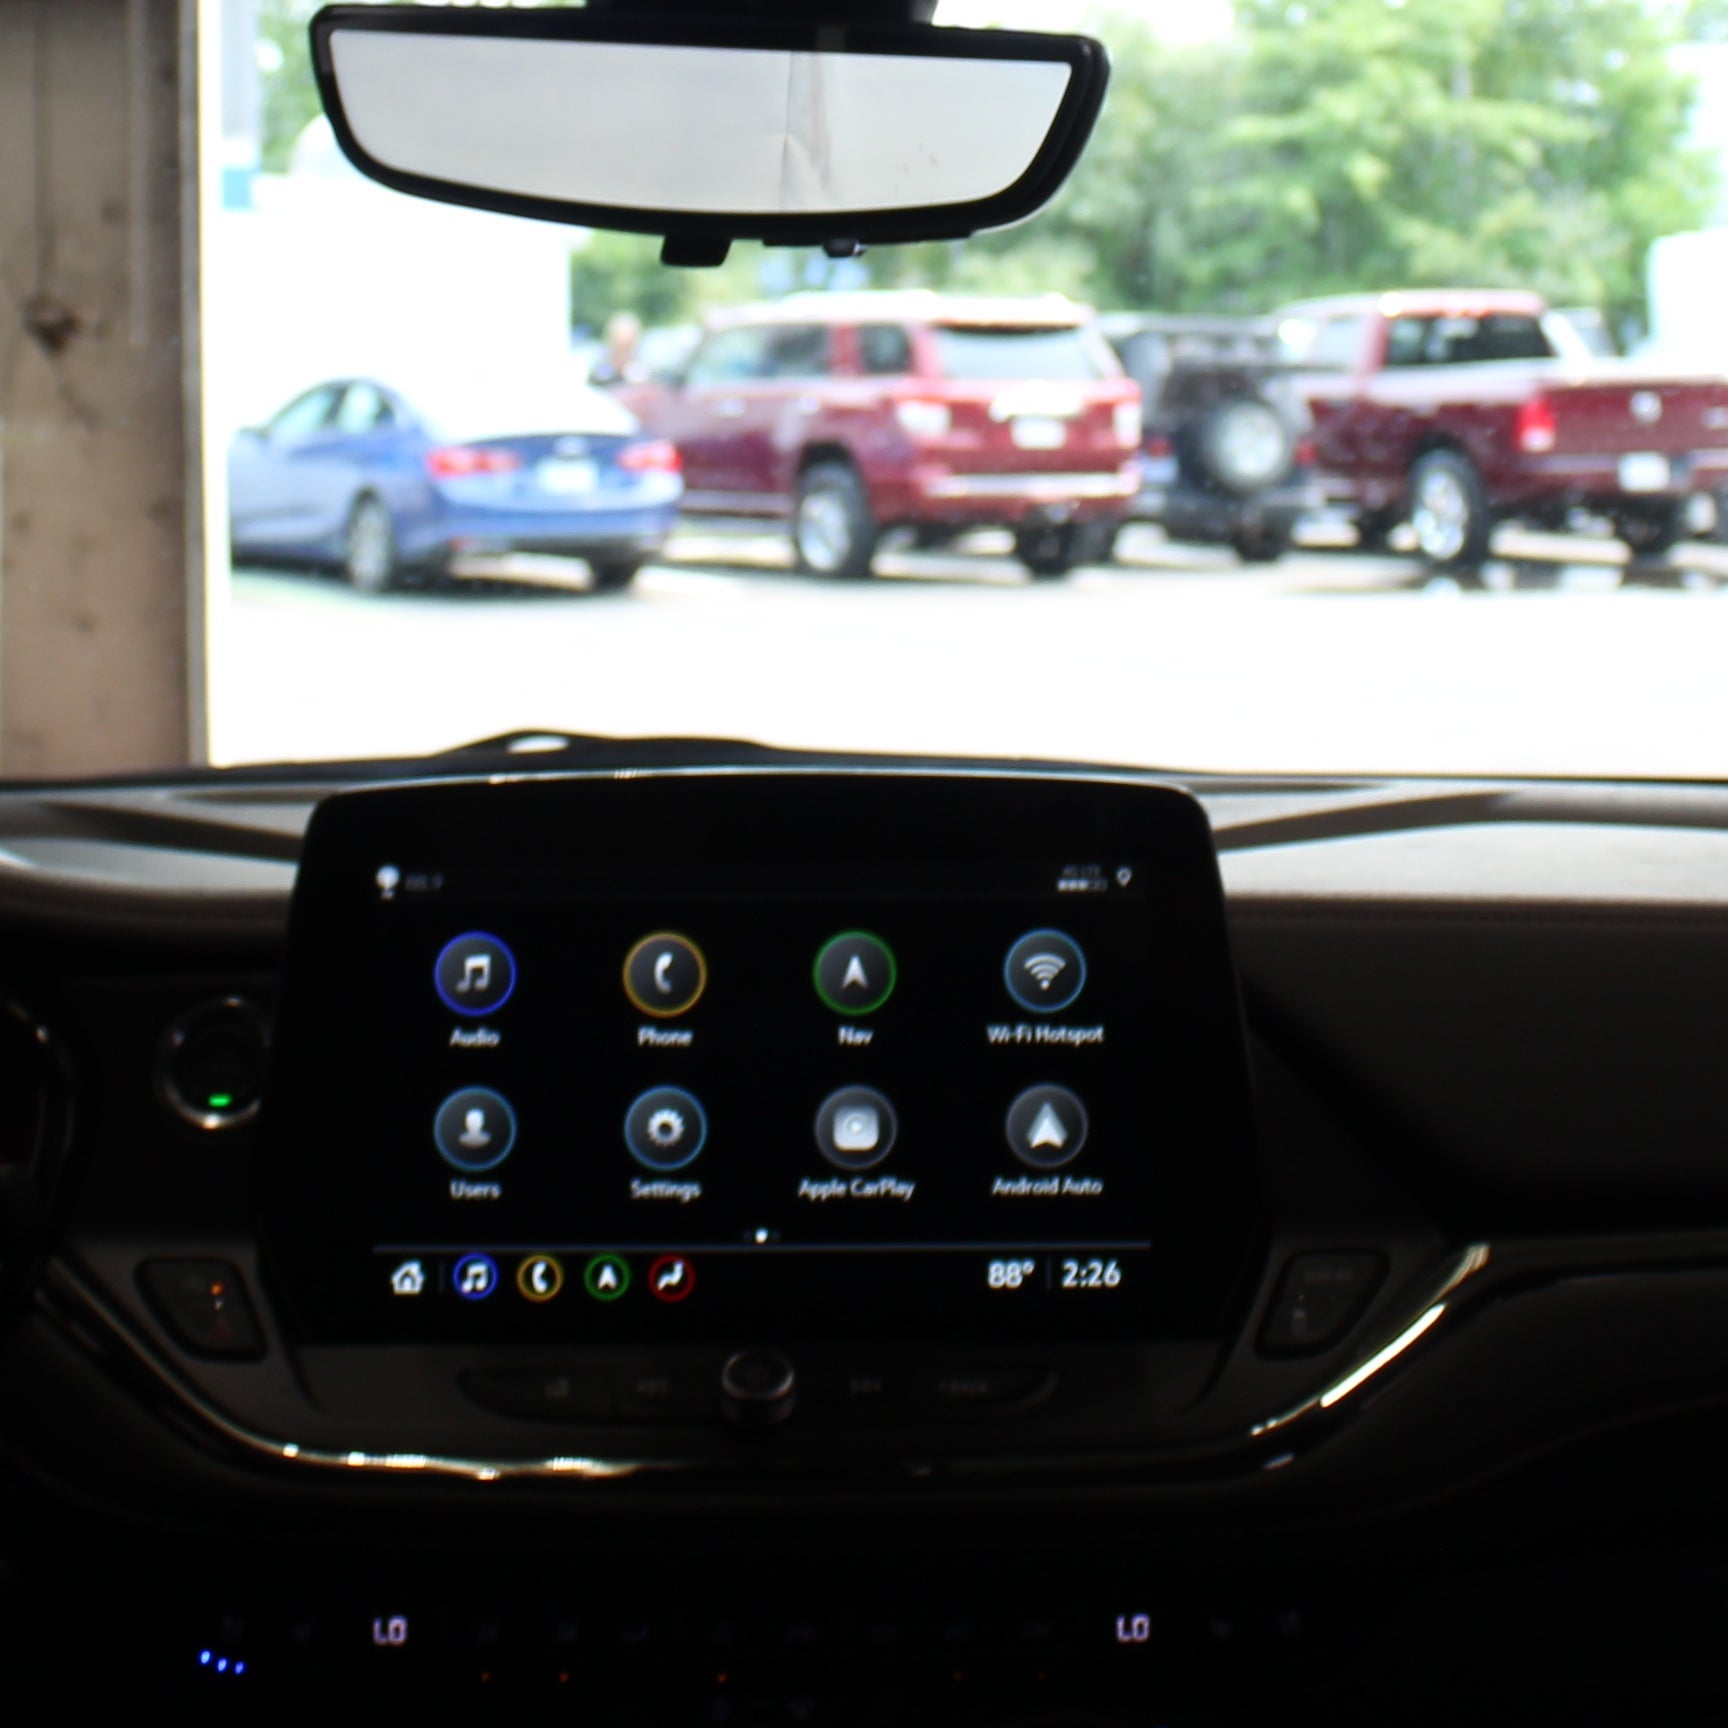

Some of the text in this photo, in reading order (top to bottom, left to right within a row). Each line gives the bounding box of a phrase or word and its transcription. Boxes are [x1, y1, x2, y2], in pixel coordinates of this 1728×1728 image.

[450, 1026, 501, 1047] Audio
[638, 1025, 694, 1047] Phone
[838, 1025, 874, 1046] Nav
[987, 1023, 1104, 1047] Wi-Fi Hotspot
[450, 1177, 501, 1200] Users
[630, 1177, 701, 1203] Settings
[798, 1176, 916, 1202] Apple CarPlay
[992, 1175, 1104, 1197] Android Auto
[1062, 1257, 1122, 1288] 2:26
